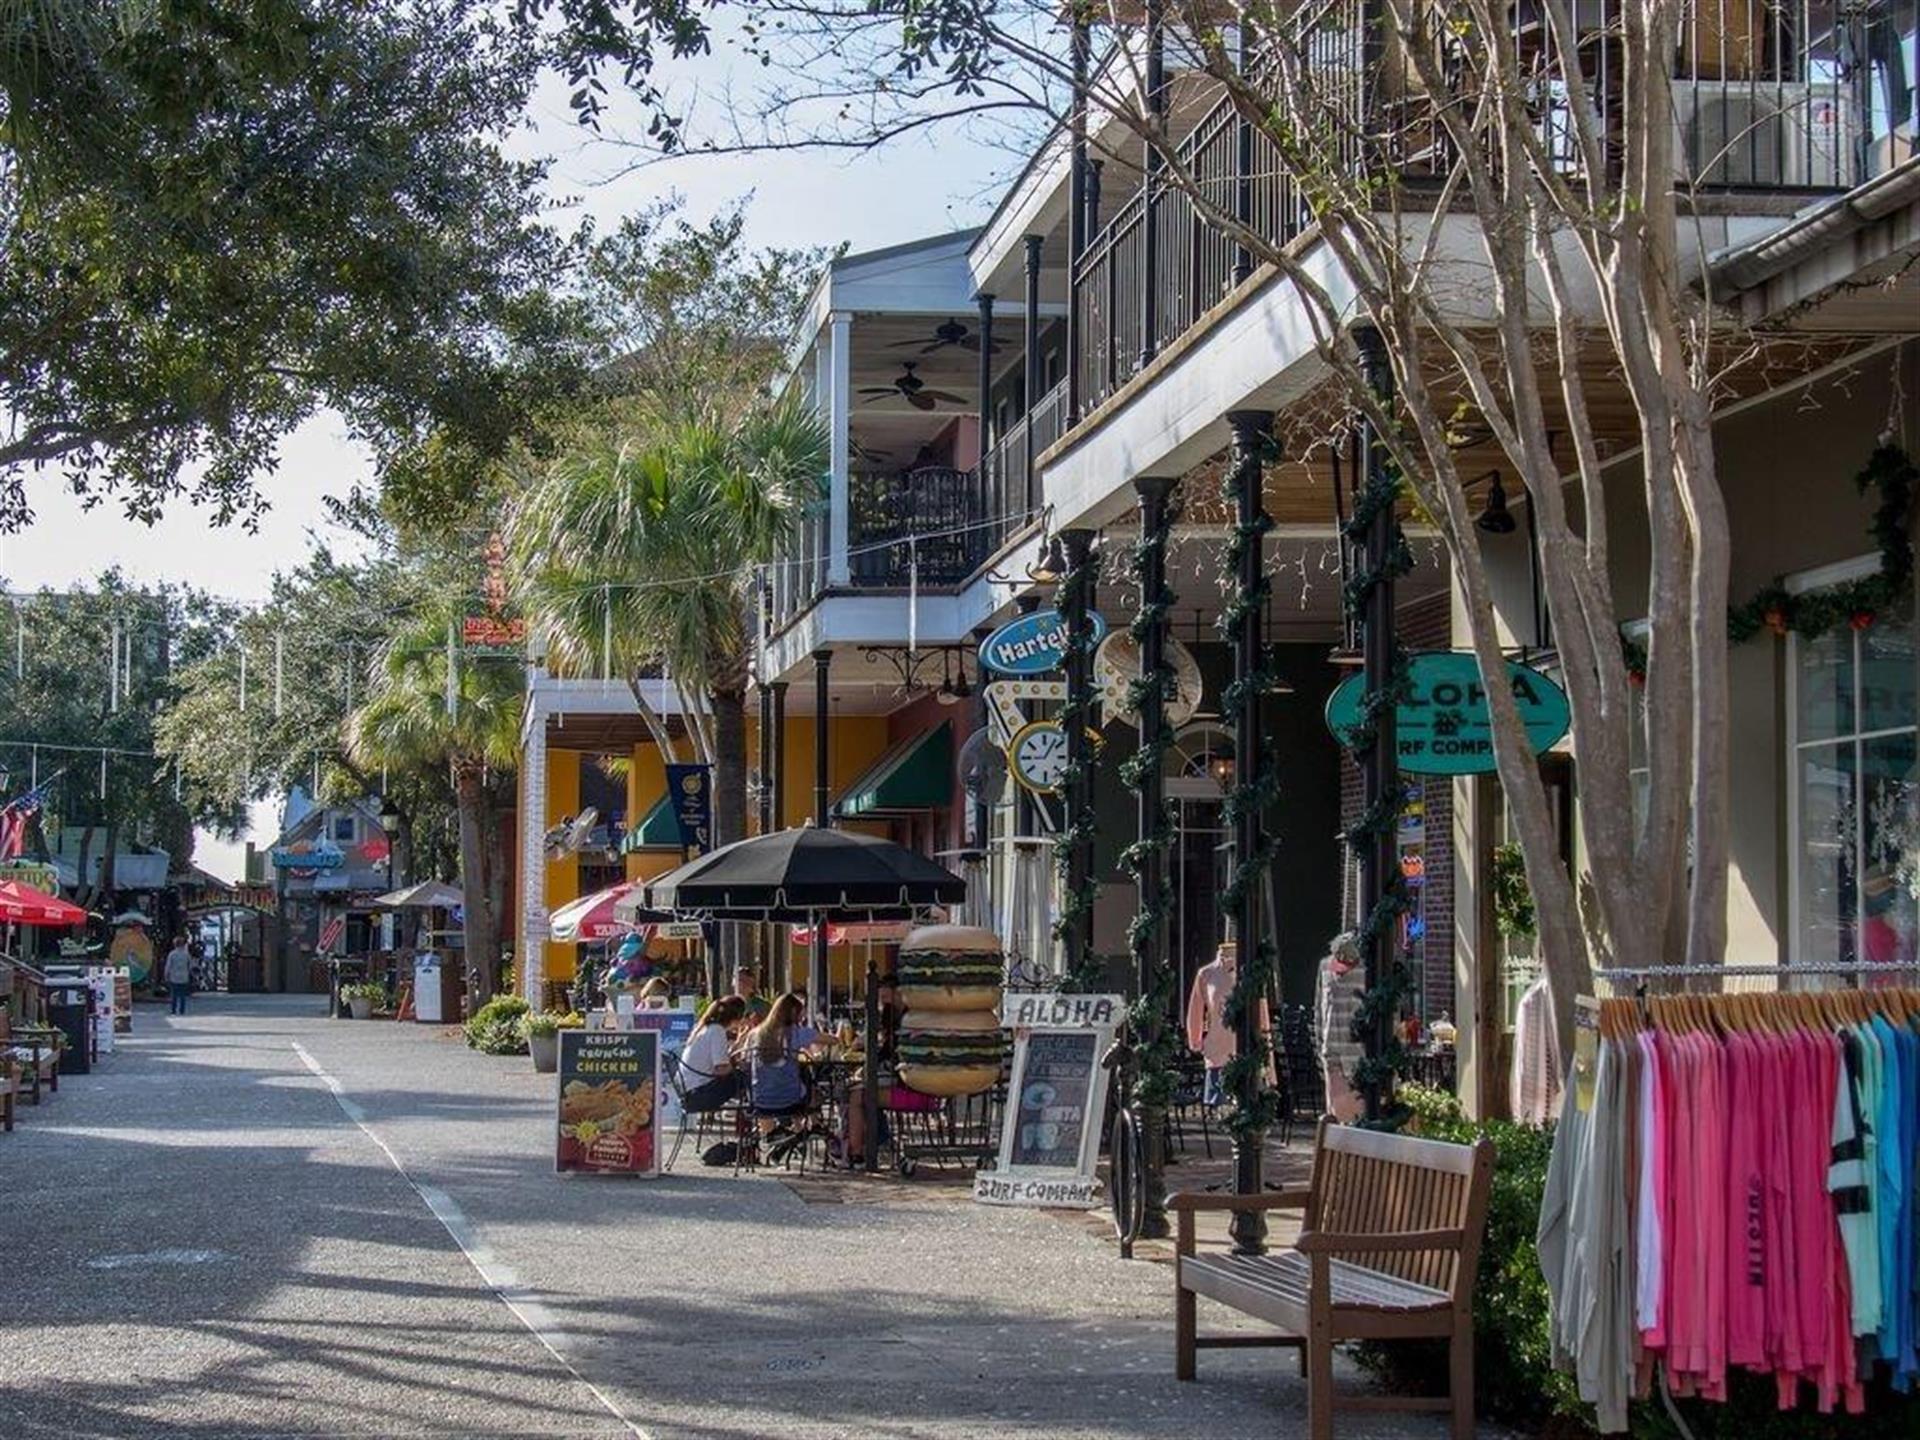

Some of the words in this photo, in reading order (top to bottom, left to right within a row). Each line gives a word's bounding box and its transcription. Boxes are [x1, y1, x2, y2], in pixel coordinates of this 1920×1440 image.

[1433, 739, 1495, 756] COMP
[1018, 998, 1113, 1025] ALOHA
[585, 1035, 629, 1045] KRISPY
[577, 1047, 636, 1059] KRUNCHY
[576, 1062, 638, 1073] CHICKEN
[977, 1180, 1022, 1201] SURF
[1026, 1181, 1097, 1203] COMPANY
